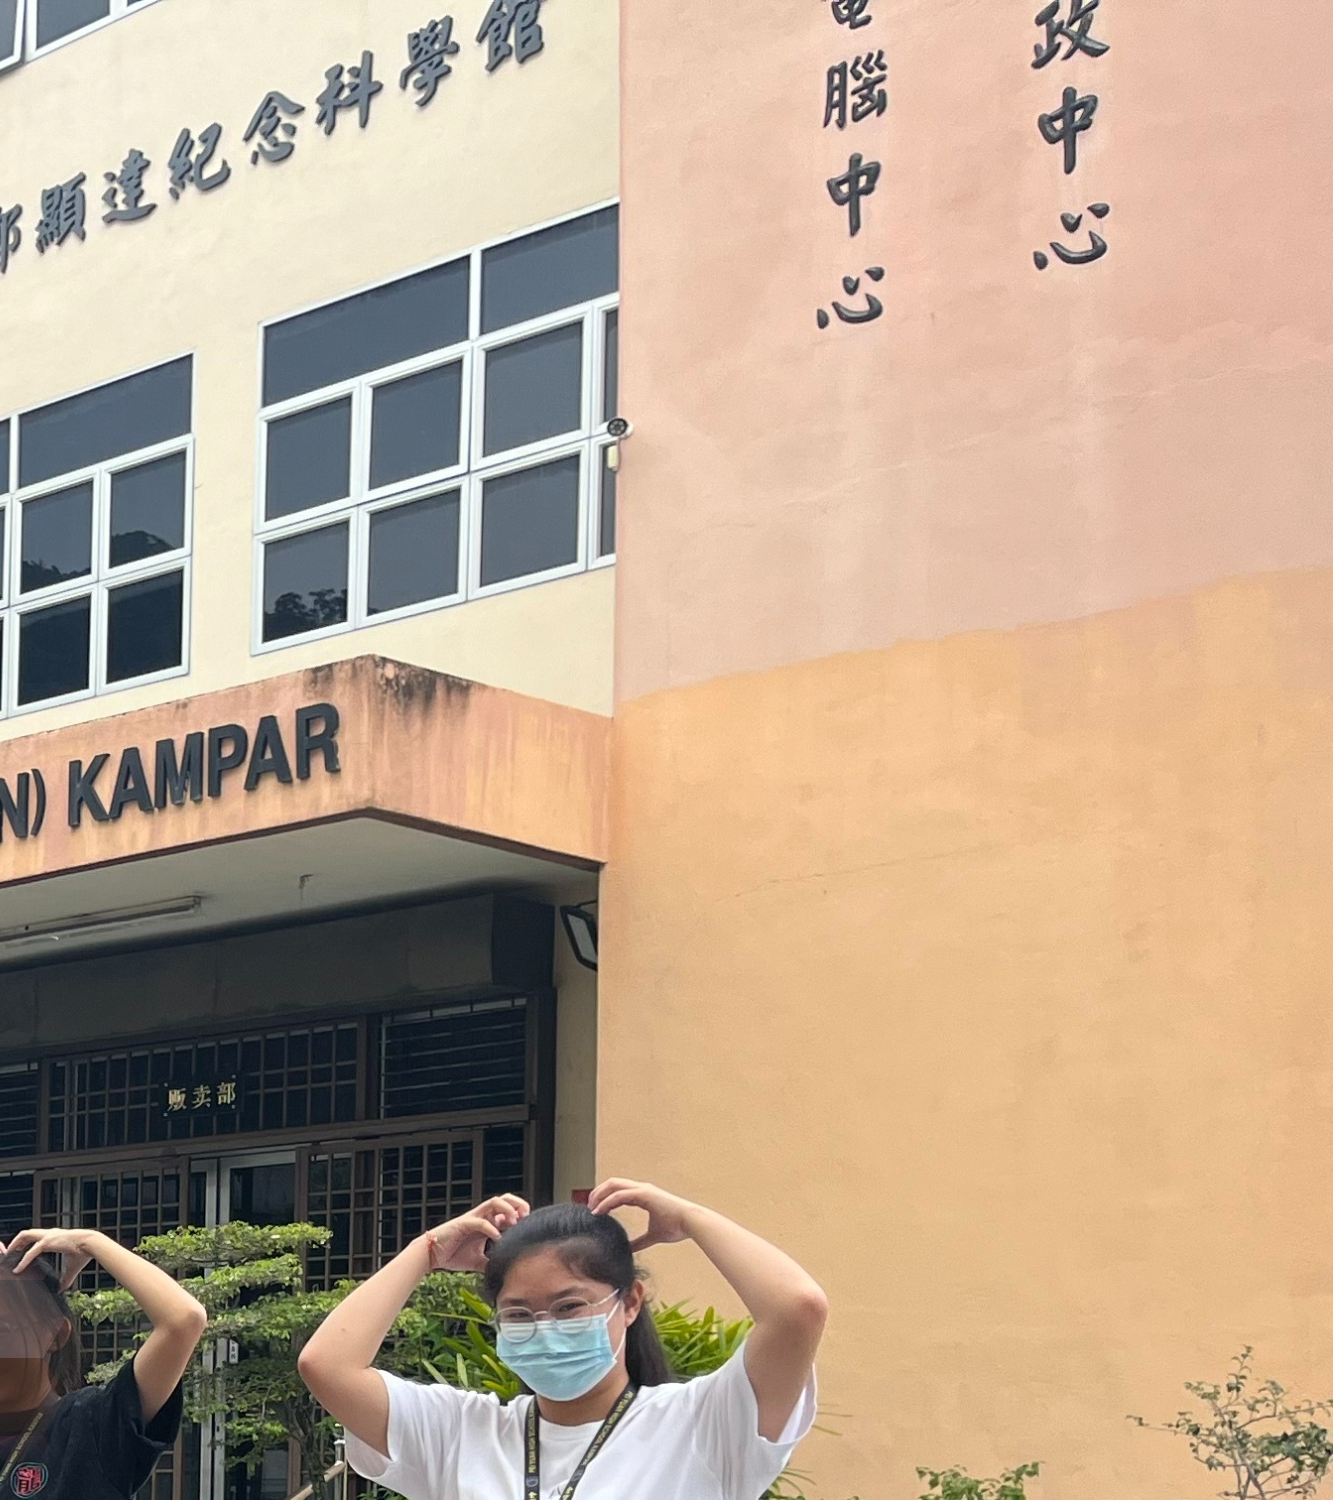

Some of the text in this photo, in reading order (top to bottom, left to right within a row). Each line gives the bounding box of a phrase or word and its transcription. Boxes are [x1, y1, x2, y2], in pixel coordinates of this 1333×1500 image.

[68, 702, 341, 828] KAMPAR
[167, 1081, 237, 1112] 贩卖部
